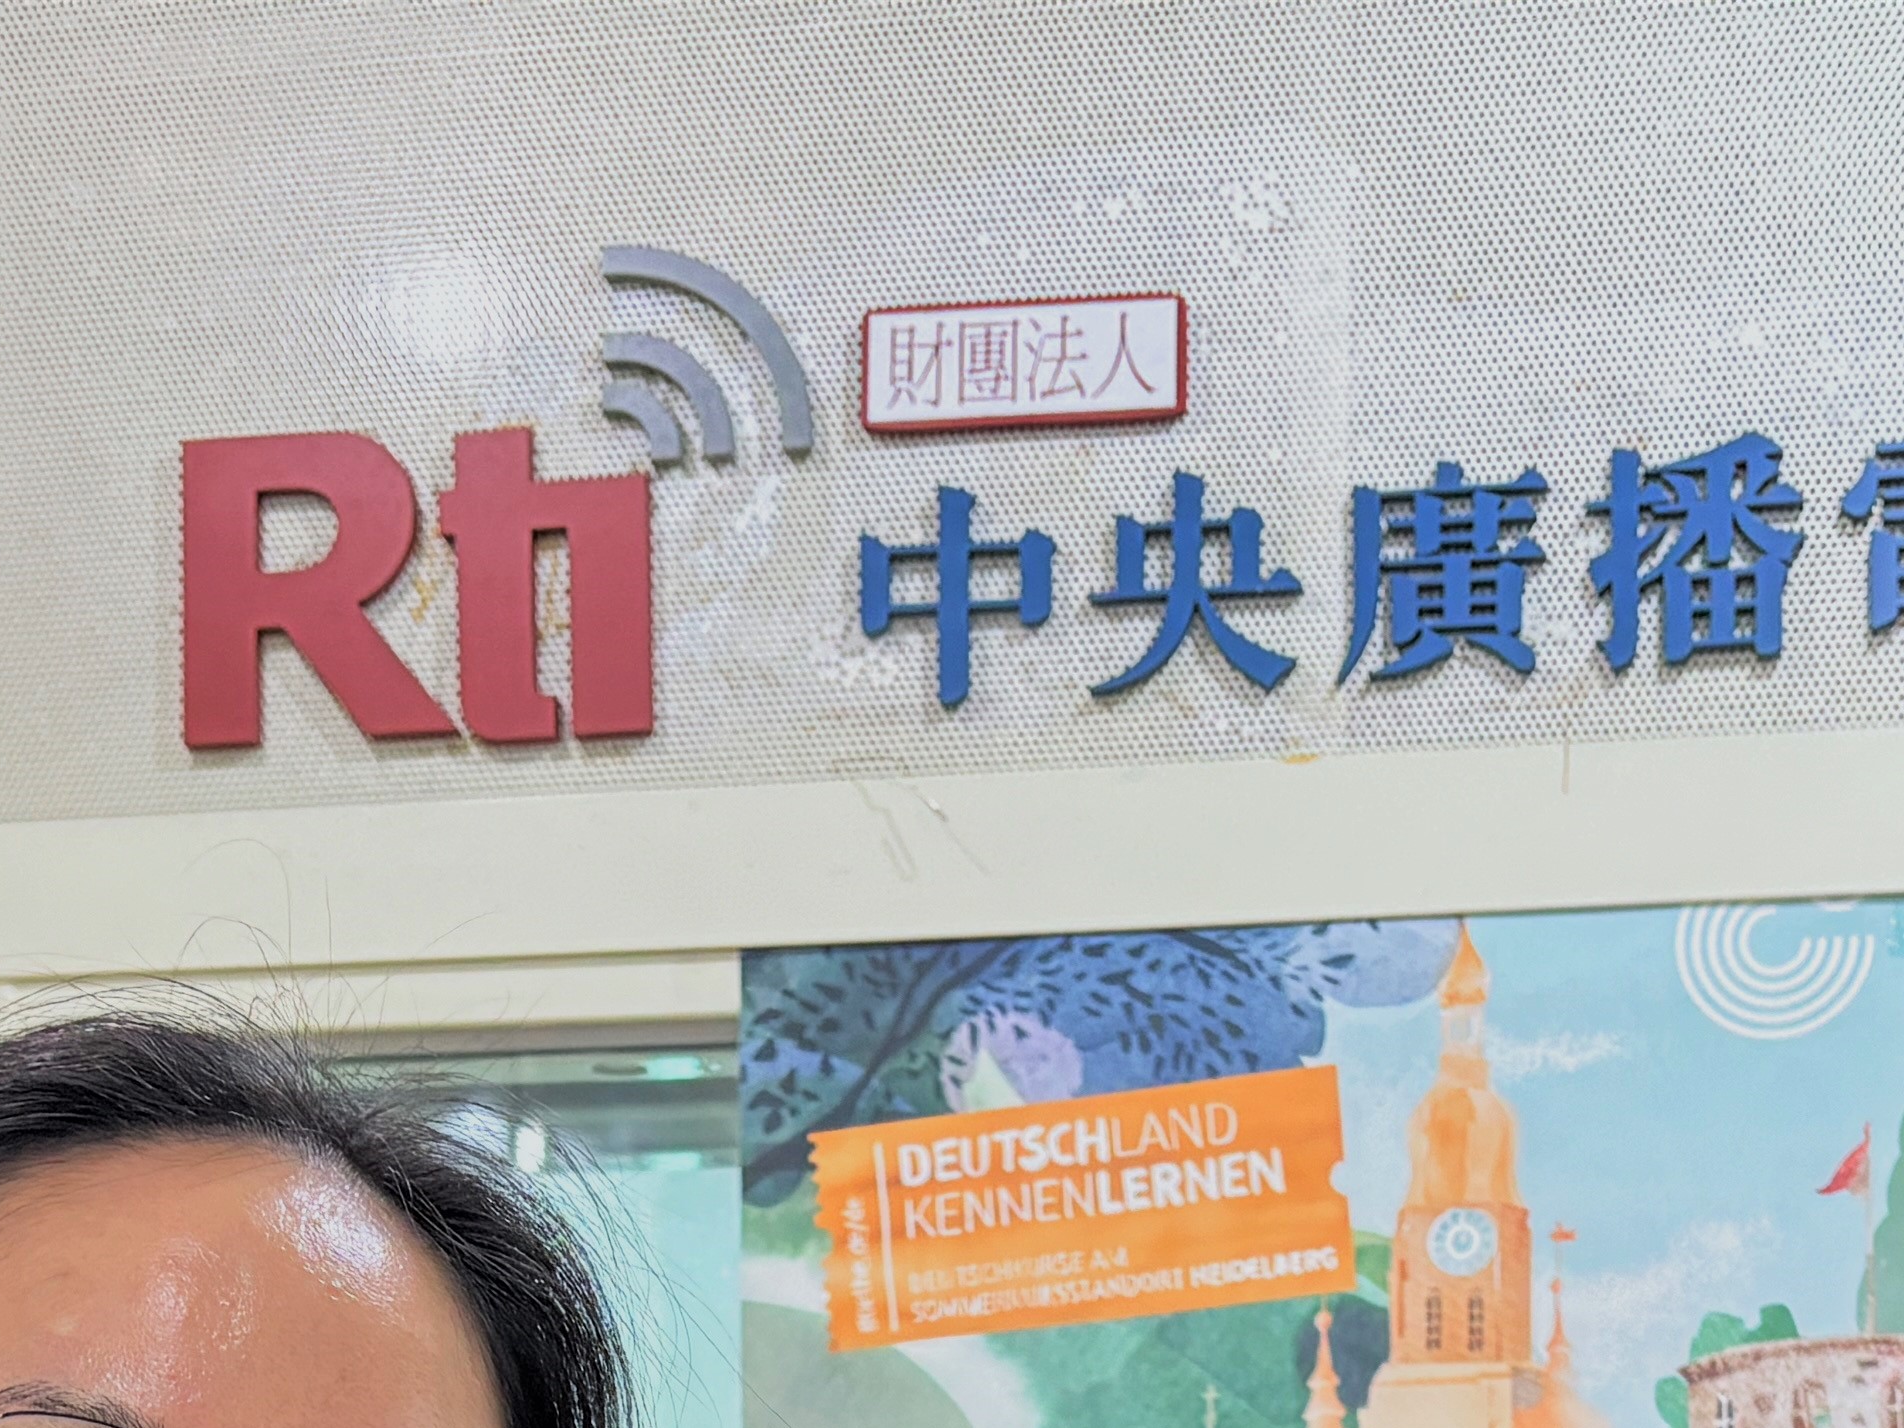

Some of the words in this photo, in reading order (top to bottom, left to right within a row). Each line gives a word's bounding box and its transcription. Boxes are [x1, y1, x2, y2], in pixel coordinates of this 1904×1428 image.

[883, 314, 1161, 408] 財團法人
[898, 1101, 1239, 1188] DEUTSCHLAND
[903, 1147, 1288, 1240] KENNENLERNEN
